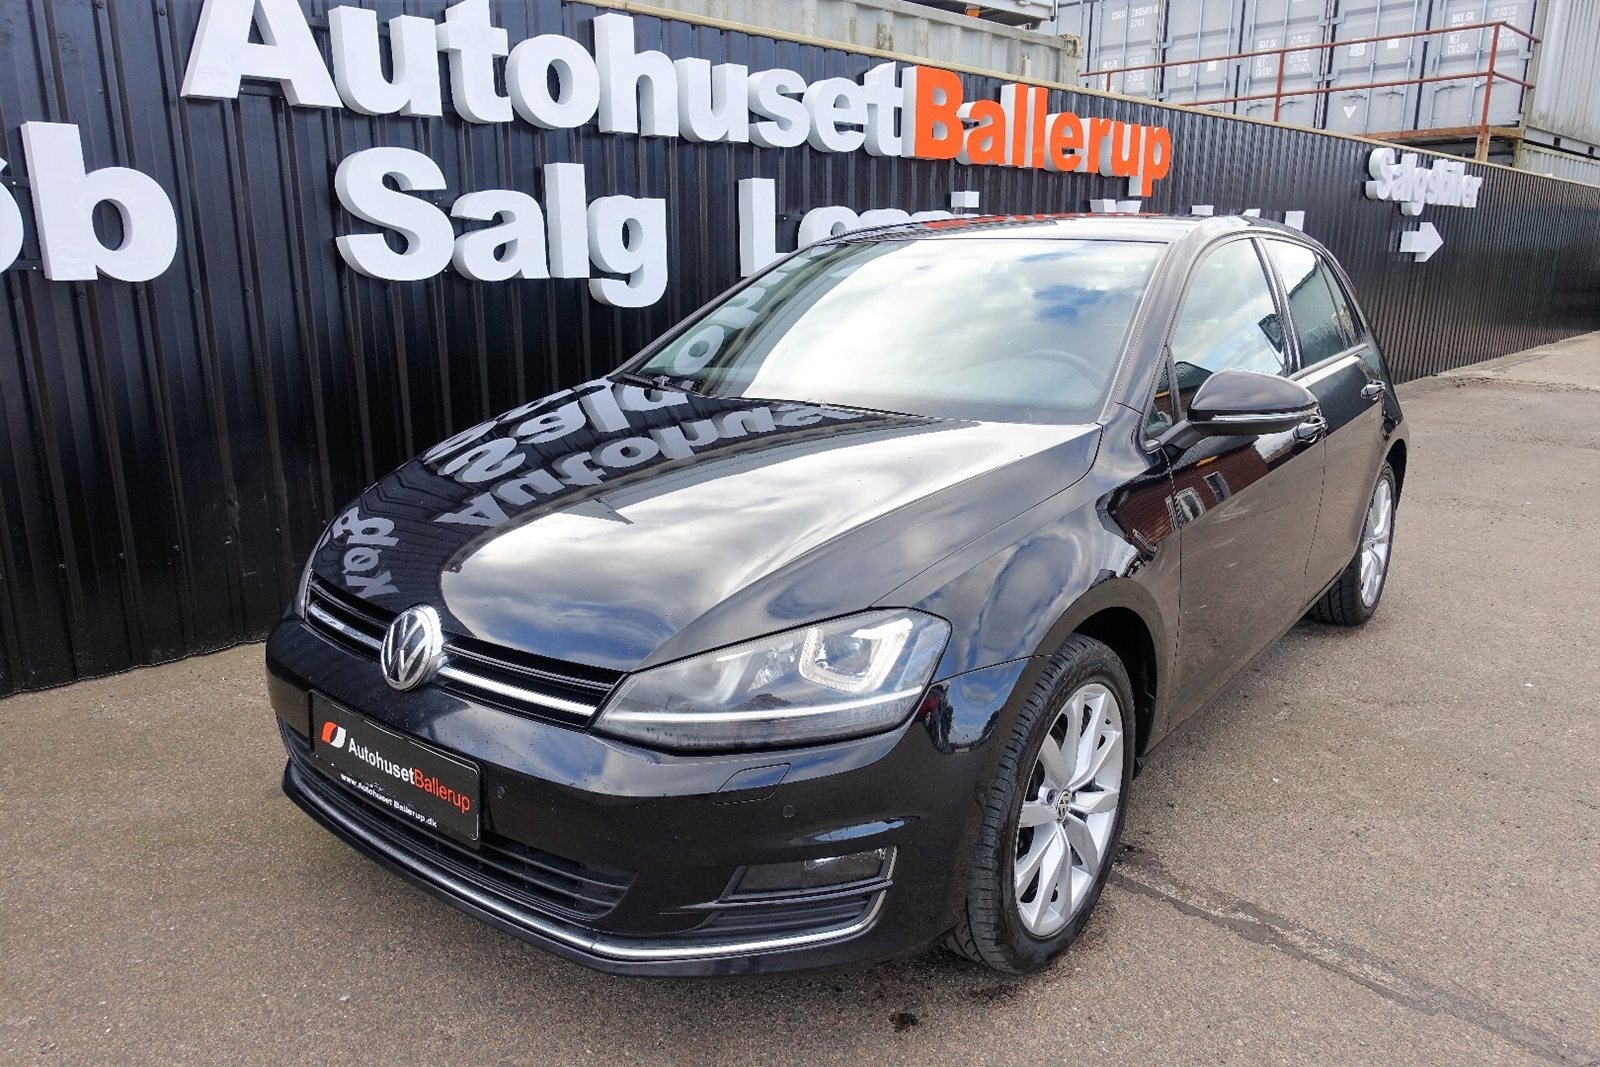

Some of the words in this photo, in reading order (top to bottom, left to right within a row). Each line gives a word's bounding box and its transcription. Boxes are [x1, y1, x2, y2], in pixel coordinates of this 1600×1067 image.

[0, 121, 178, 282] b
[334, 146, 668, 308] Salg
[348, 737, 471, 814] AutohusetBallerup
